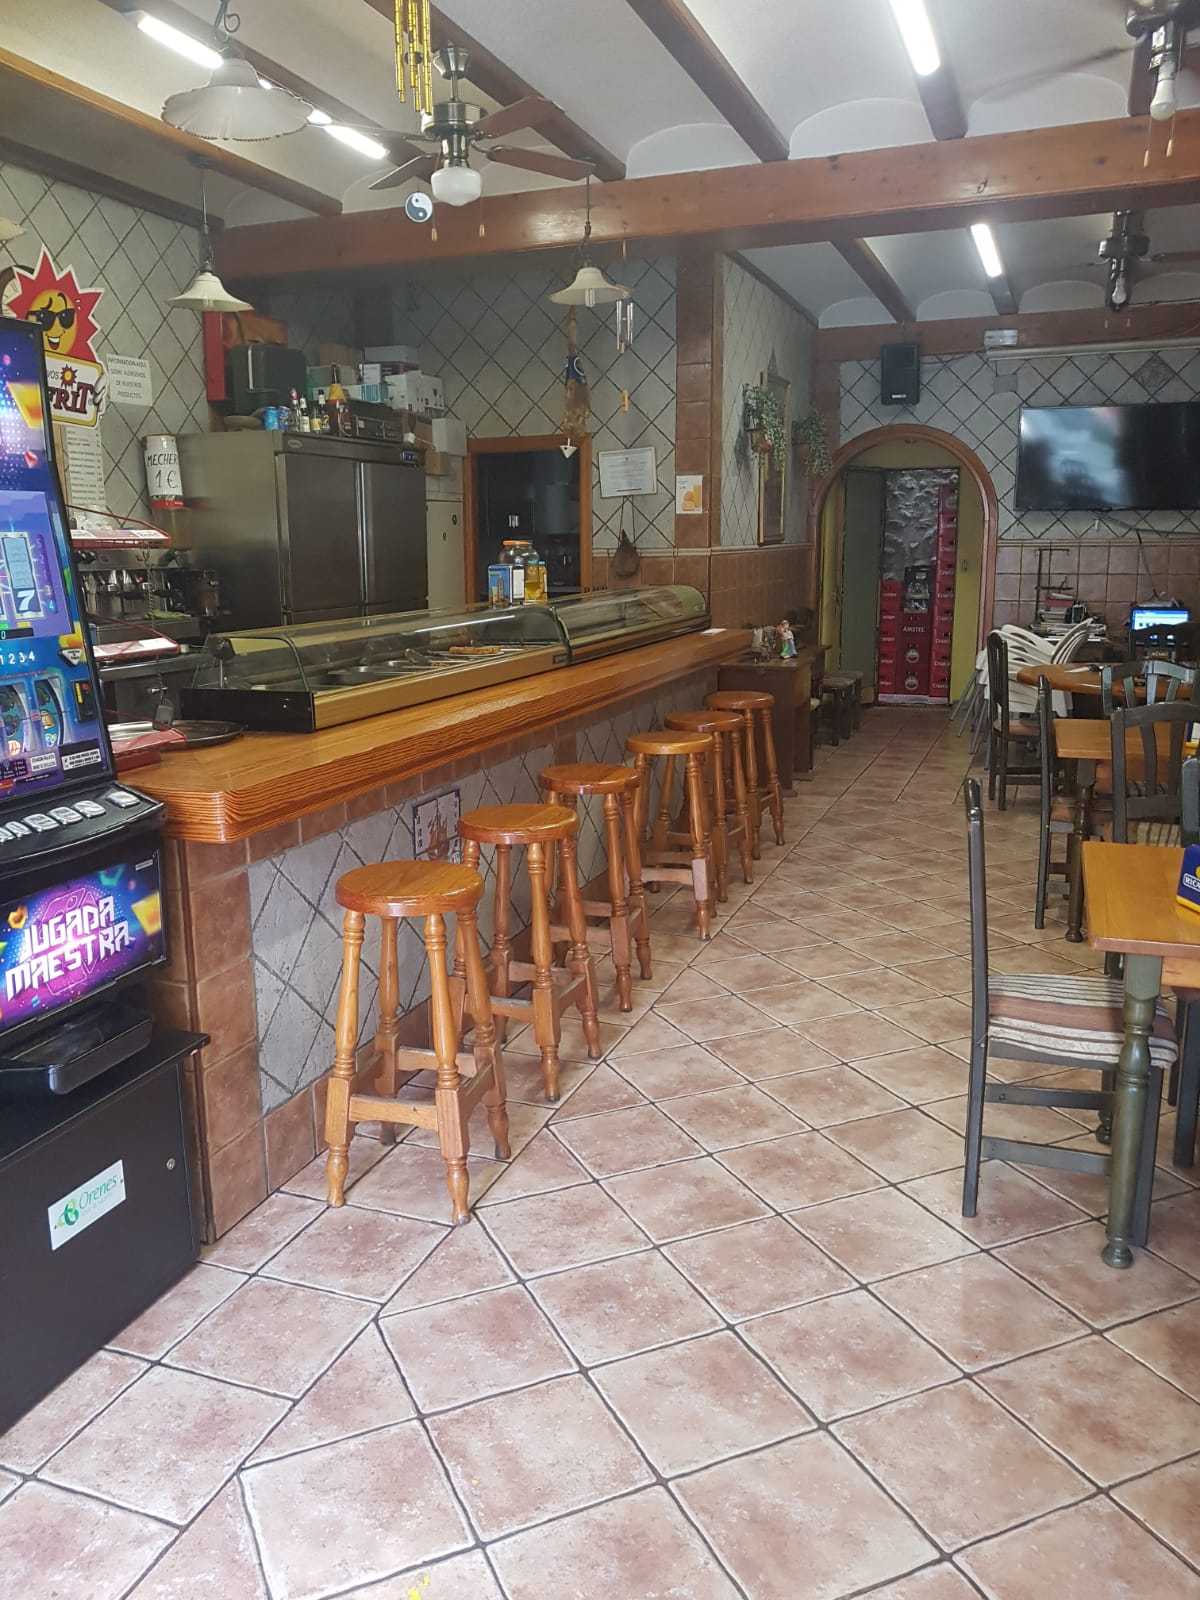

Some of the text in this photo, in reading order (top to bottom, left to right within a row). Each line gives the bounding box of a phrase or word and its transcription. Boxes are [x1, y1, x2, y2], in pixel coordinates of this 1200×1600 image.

[16, 589, 35, 612] 7
[5, 920, 131, 1002] MAESTRA
[18, 896, 115, 962] JUGADA
